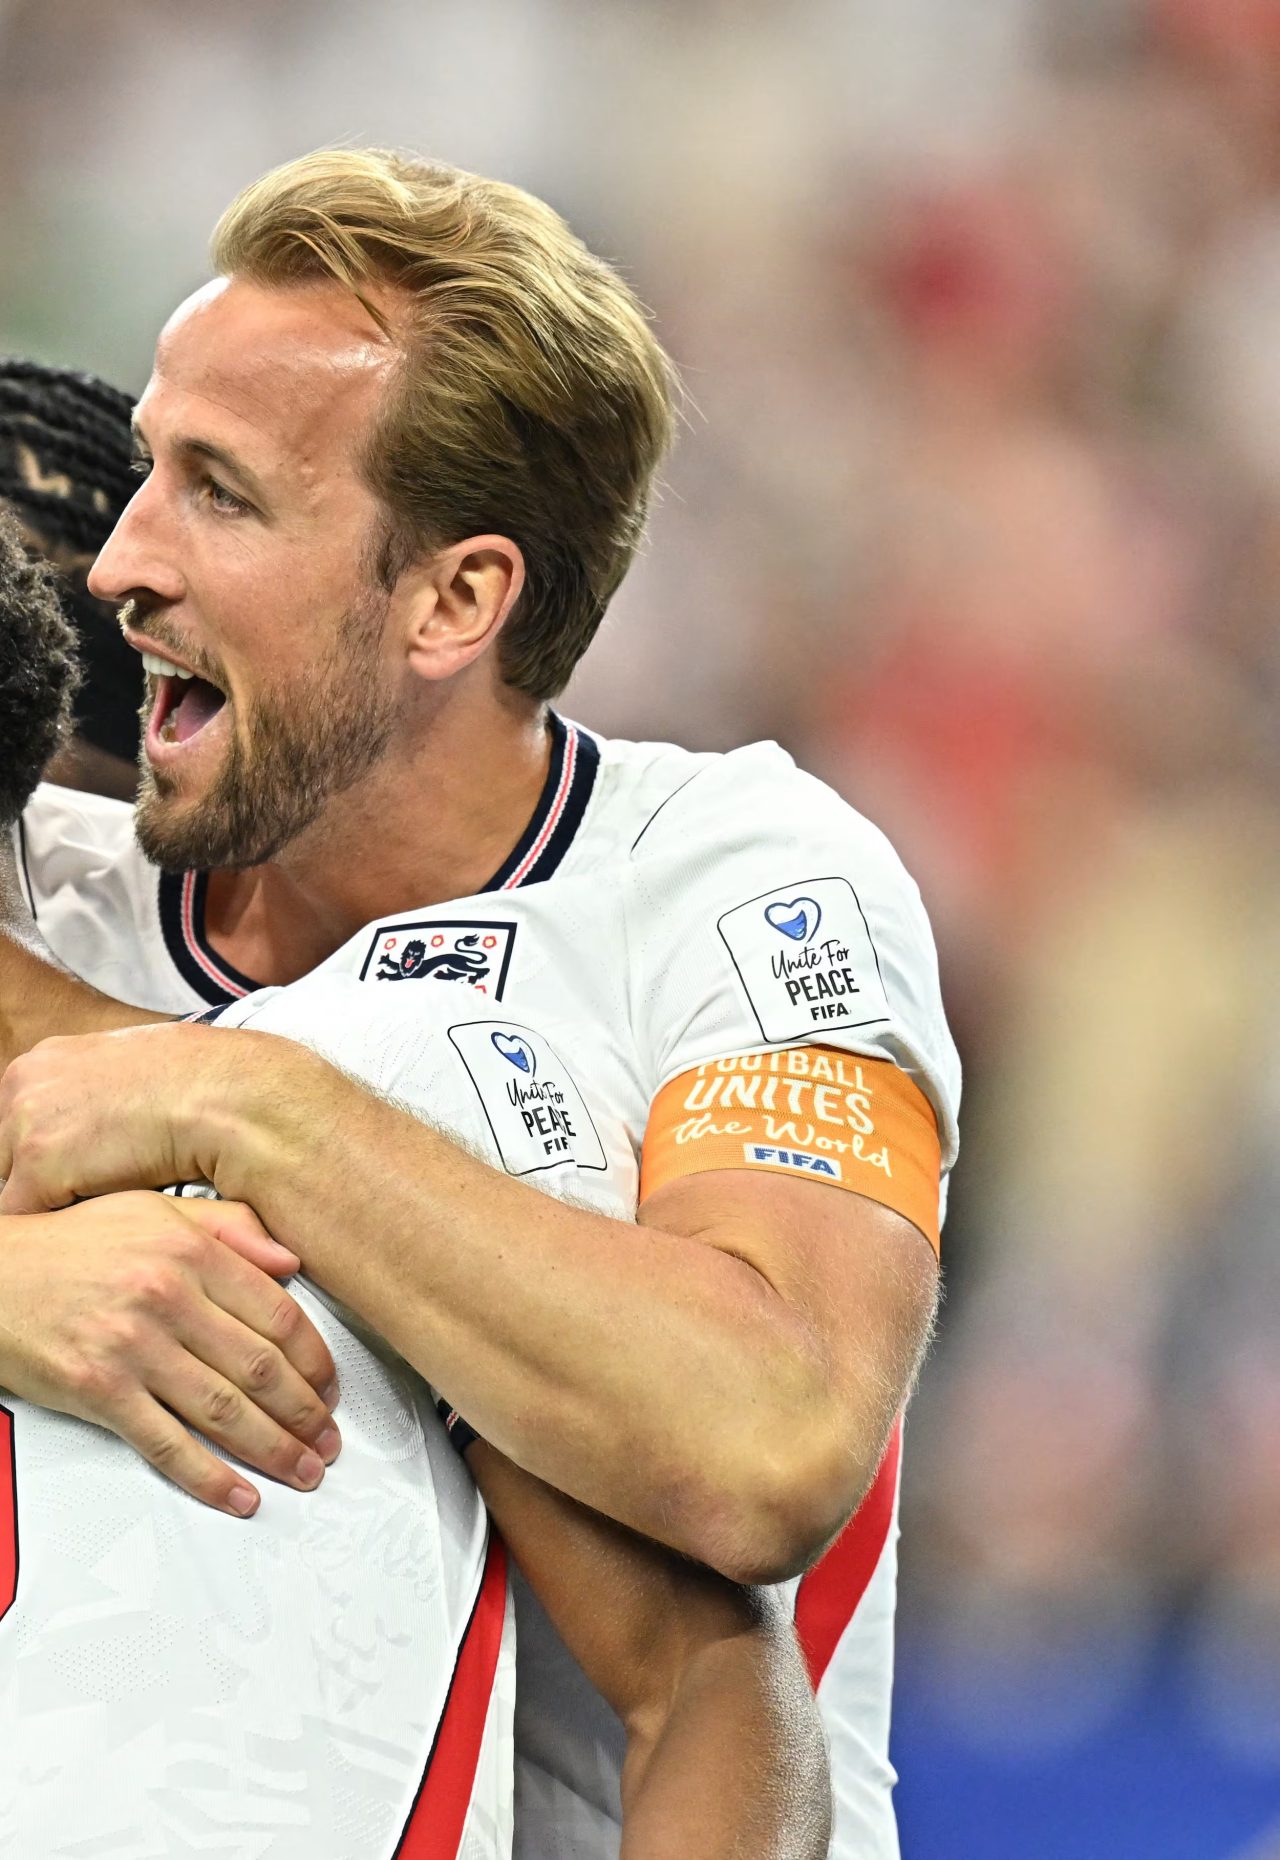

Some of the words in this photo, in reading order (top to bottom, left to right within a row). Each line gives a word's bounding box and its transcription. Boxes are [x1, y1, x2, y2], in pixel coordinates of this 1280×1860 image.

[771, 947, 822, 979] Unite
[820, 940, 849, 967] For
[785, 968, 860, 1006] PEACE
[810, 1003, 849, 1021] FIFA
[683, 1075, 874, 1135] UNITES
[543, 1136, 569, 1155] FIF
[671, 1113, 753, 1145] the
[762, 1114, 893, 1178] World
[753, 1147, 836, 1176] FIFA
